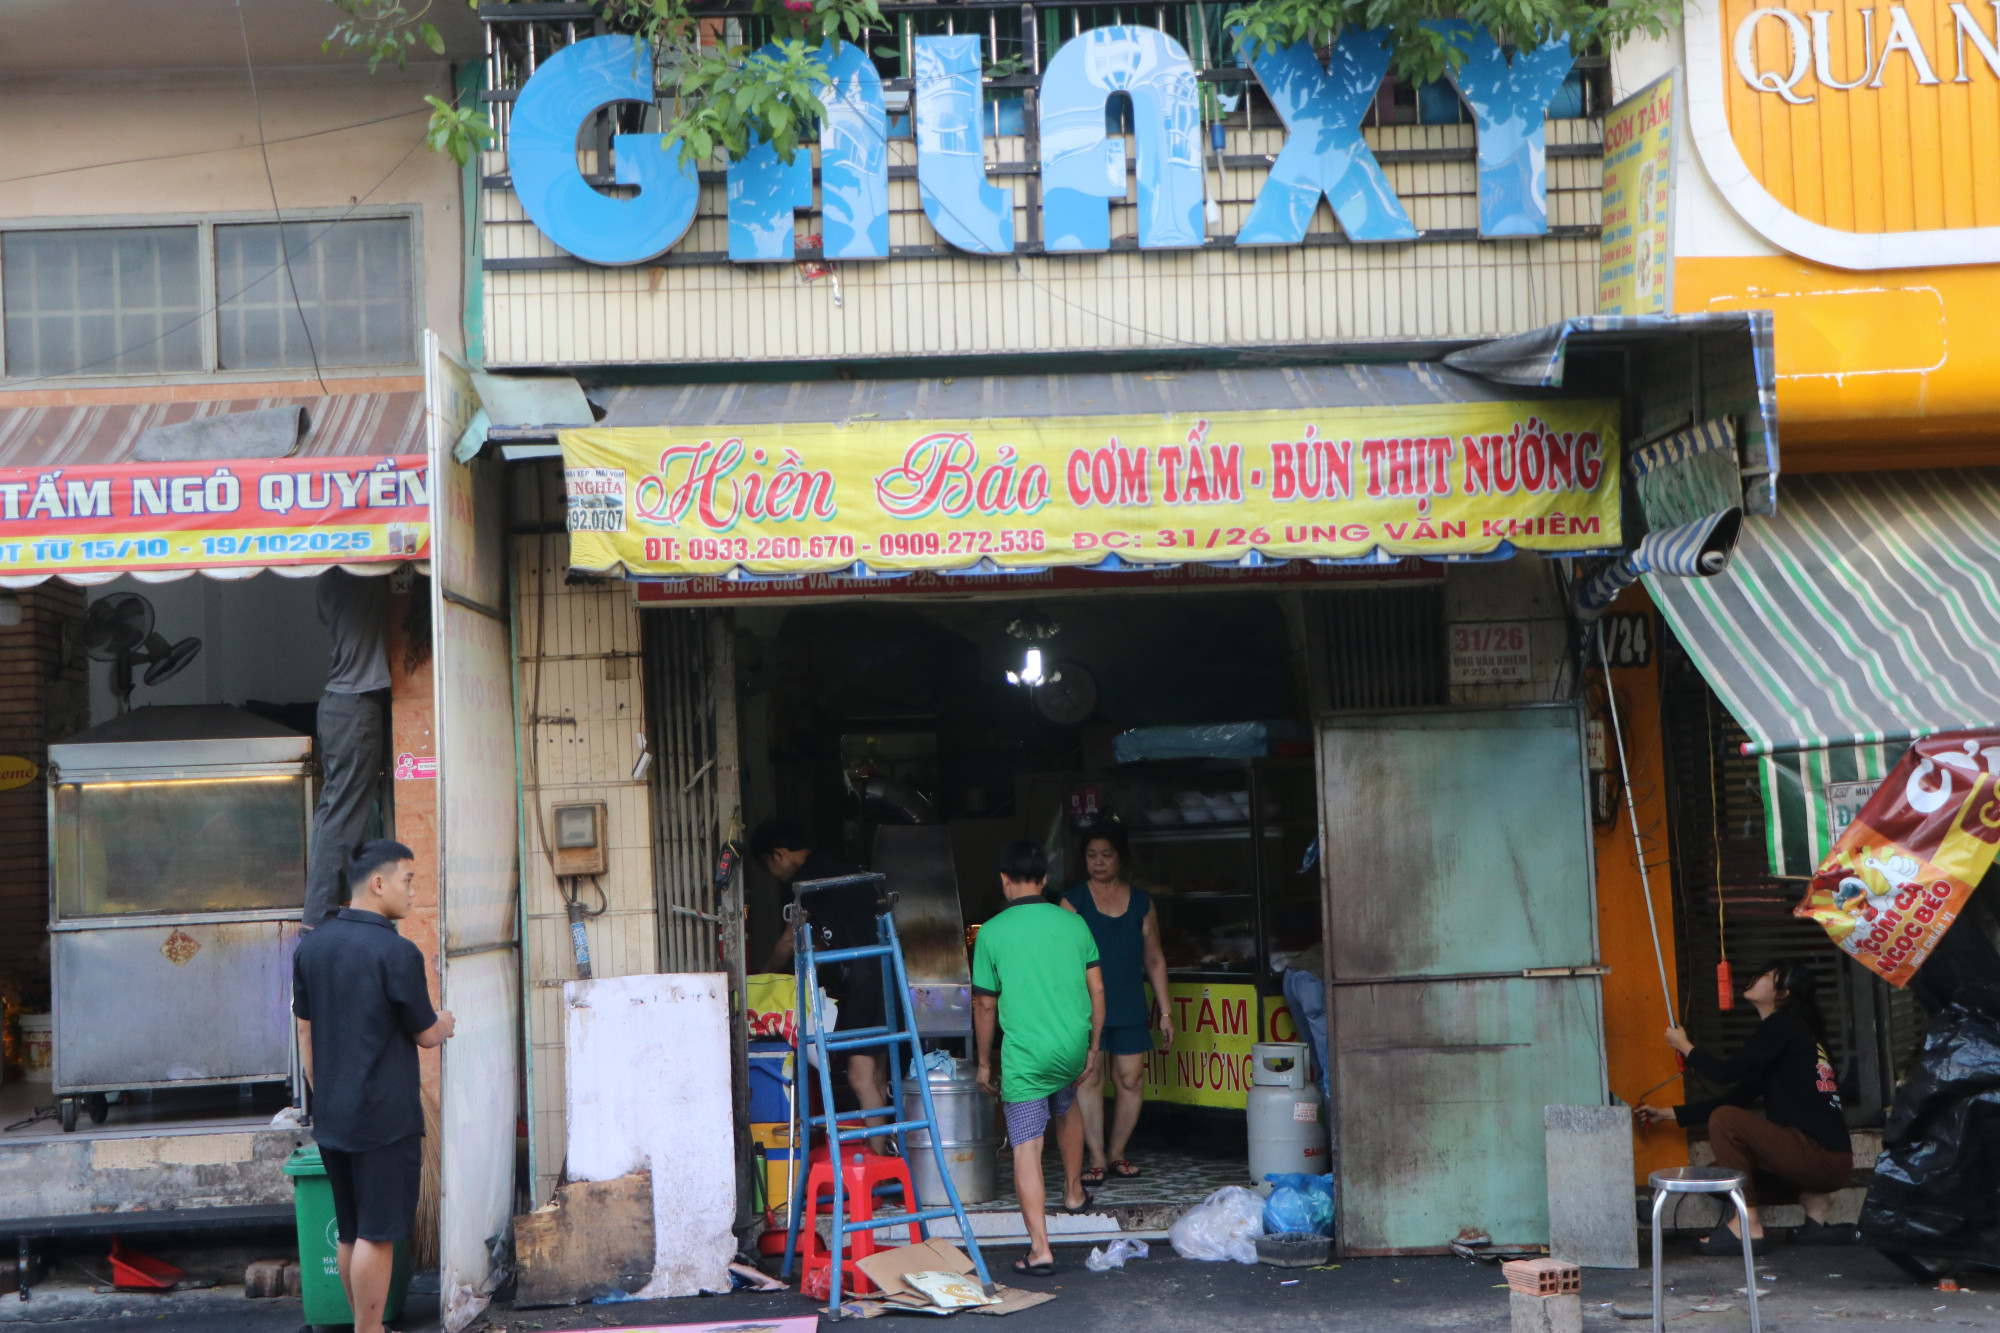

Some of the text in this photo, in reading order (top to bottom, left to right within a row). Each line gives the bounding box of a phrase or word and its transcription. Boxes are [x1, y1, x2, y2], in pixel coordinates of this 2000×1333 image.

[1605, 87, 1670, 152] CƠM TẤM
[0, 470, 112, 520] TẤM
[132, 467, 241, 516] NGÔ
[259, 457, 430, 515] QUYỀN
[575, 478, 624, 495] NGHĨA
[636, 432, 1050, 530] Hiền Bảo
[1066, 437, 1149, 506] CƠM
[1157, 419, 1242, 502] TẤM
[1271, 424, 1352, 499] BÚN
[1362, 435, 1453, 512] THỊT
[1462, 417, 1602, 495] NƯỚNG
[80, 538, 170, 560] 15/10
[202, 531, 372, 555] 19/102025
[645, 539, 681, 561] ĐT:
[688, 534, 855, 561] 0933.260.670
[879, 529, 1046, 556] 0909.272.536
[1072, 511, 1600, 549] ĐC: 31/26 UNG VĂN KHIÊM
[1454, 627, 1524, 652] 31/26
[1173, 987, 1249, 1036] TẤM
[1176, 1042, 1253, 1093] NƯỚNG
